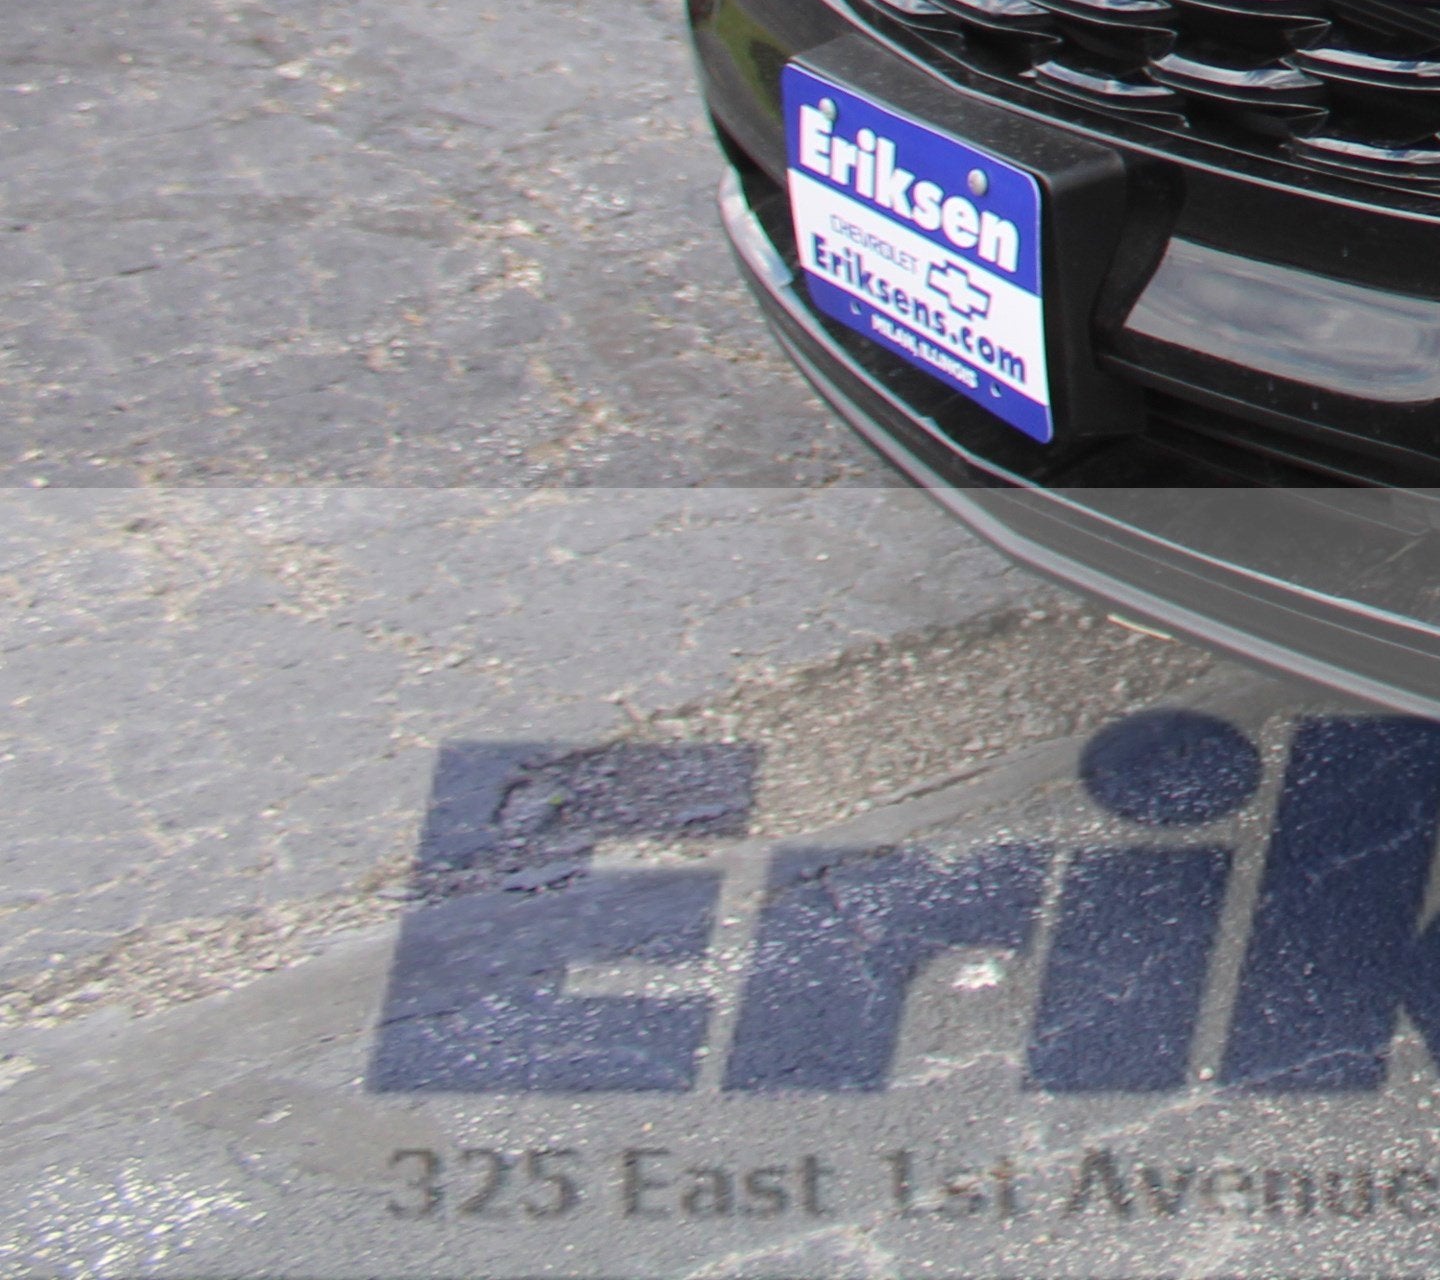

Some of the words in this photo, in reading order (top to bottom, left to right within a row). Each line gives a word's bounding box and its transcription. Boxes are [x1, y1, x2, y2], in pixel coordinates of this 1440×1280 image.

[800, 102, 1020, 273] Eriksen
[829, 213, 920, 275] CHEVROLET
[811, 232, 1026, 385] Eriksens.com
